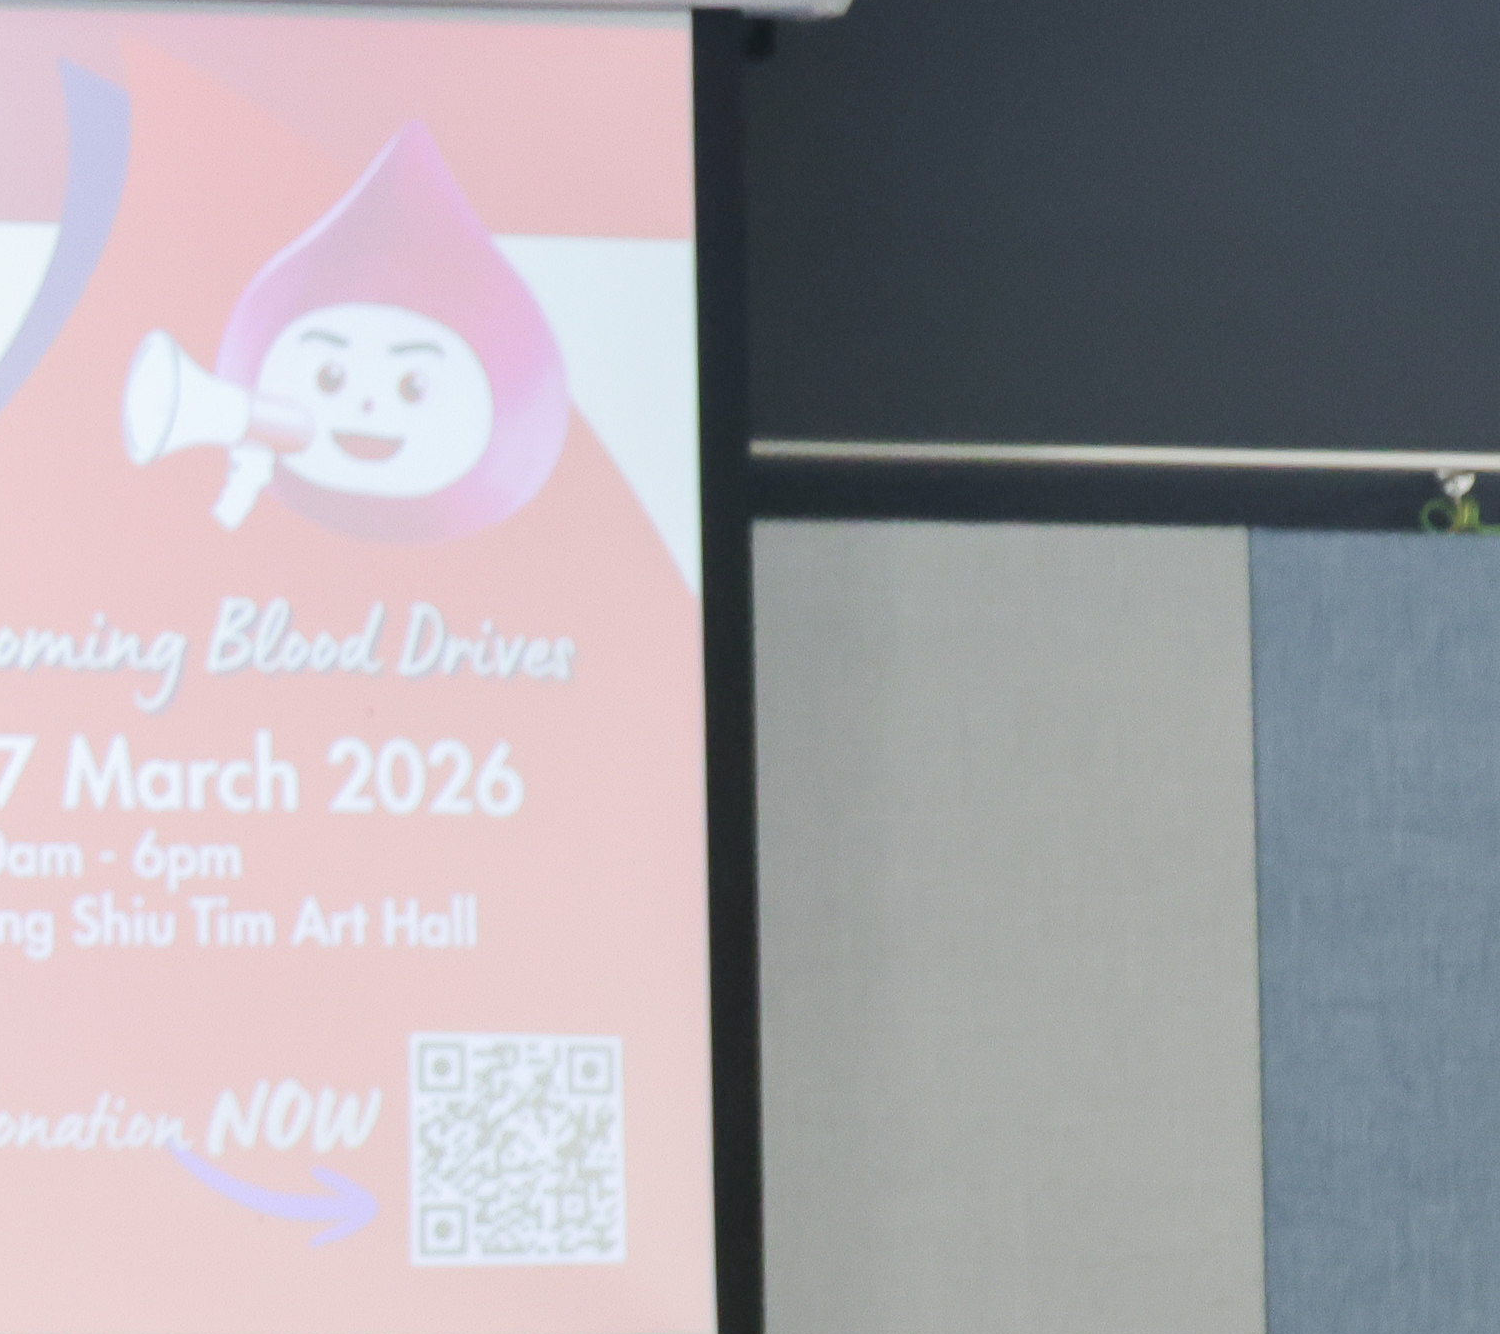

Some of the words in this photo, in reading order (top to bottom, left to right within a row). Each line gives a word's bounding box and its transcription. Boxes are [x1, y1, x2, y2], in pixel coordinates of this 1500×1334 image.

[206, 595, 386, 675] Blood
[396, 601, 577, 681] Drives
[62, 728, 300, 813] March
[327, 736, 525, 818] 2026
[132, 828, 243, 894] 6pm
[71, 889, 177, 948] Shiu
[189, 893, 276, 948] Tim
[290, 894, 370, 948] Art
[381, 893, 478, 949] Hall
[206, 1078, 384, 1158] NOW
